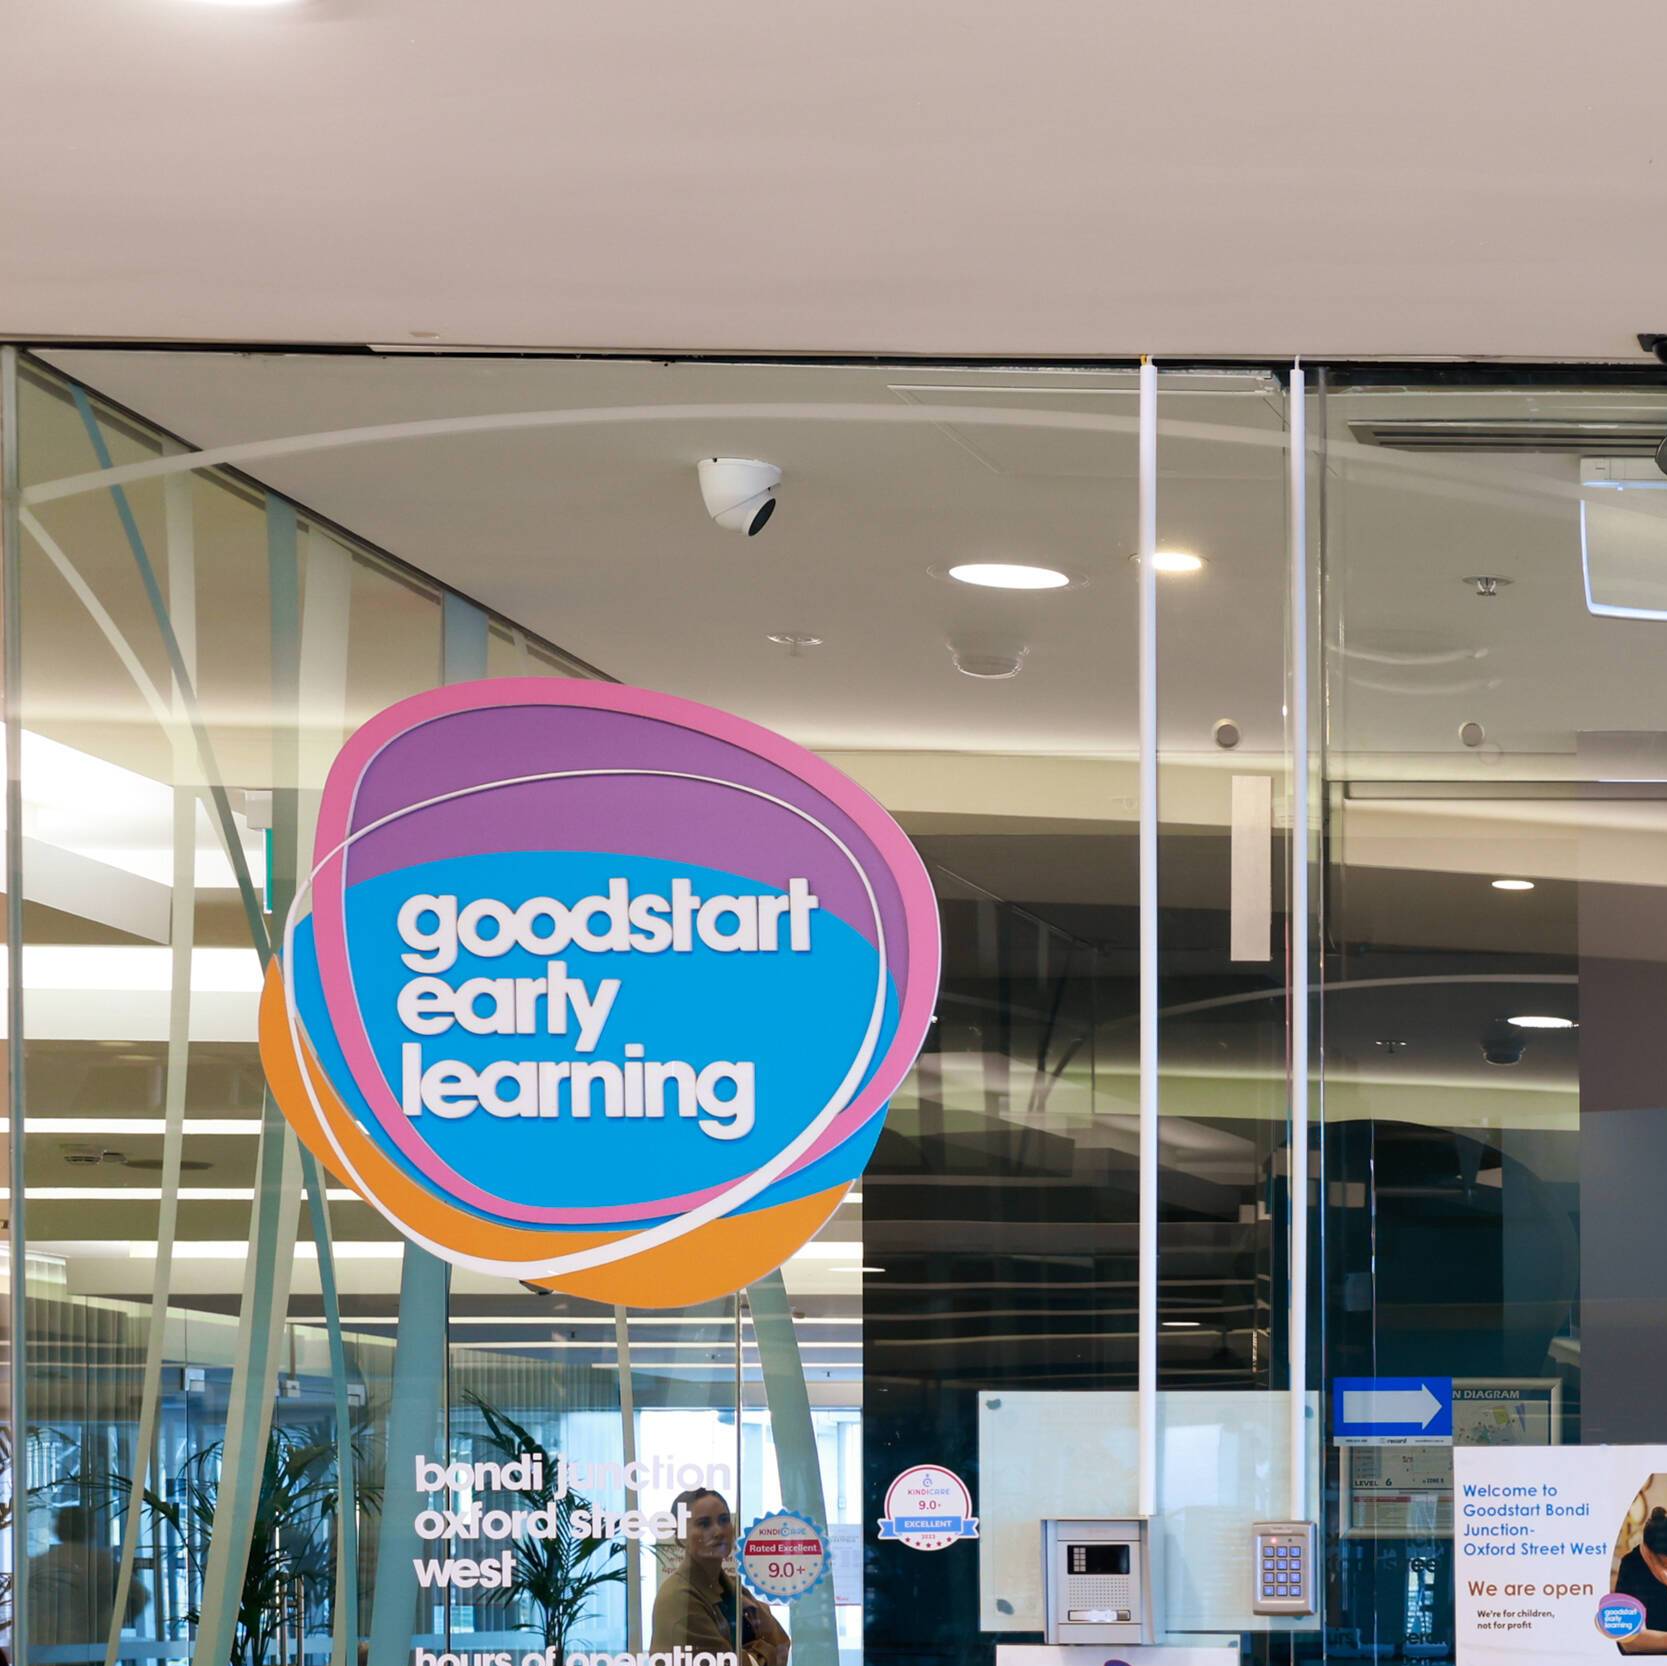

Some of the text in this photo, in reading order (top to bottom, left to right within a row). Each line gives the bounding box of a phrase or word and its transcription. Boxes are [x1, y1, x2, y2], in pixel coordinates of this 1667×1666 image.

[397, 878, 819, 974] goodstart
[397, 961, 621, 1051] early
[402, 1042, 755, 1139] learning
[1464, 1390, 1520, 1399] DIAGRAM
[416, 1453, 732, 1499] bondi junction
[1463, 1484, 1558, 1497] Welcome to
[1463, 1503, 1590, 1517] Goodstart Bondi
[414, 1502, 692, 1540] oxford street
[904, 1520, 952, 1528] EXCELLENT
[1463, 1524, 1535, 1537] Junction-
[750, 1544, 817, 1553] Rated Excellent
[1464, 1542, 1608, 1556] Oxford Street West
[413, 1549, 517, 1588] west
[768, 1563, 806, 1578] 9.0+
[1468, 1581, 1594, 1599] We are open
[1477, 1610, 1555, 1619] We're for children,
[1477, 1621, 1533, 1631] not for profit
